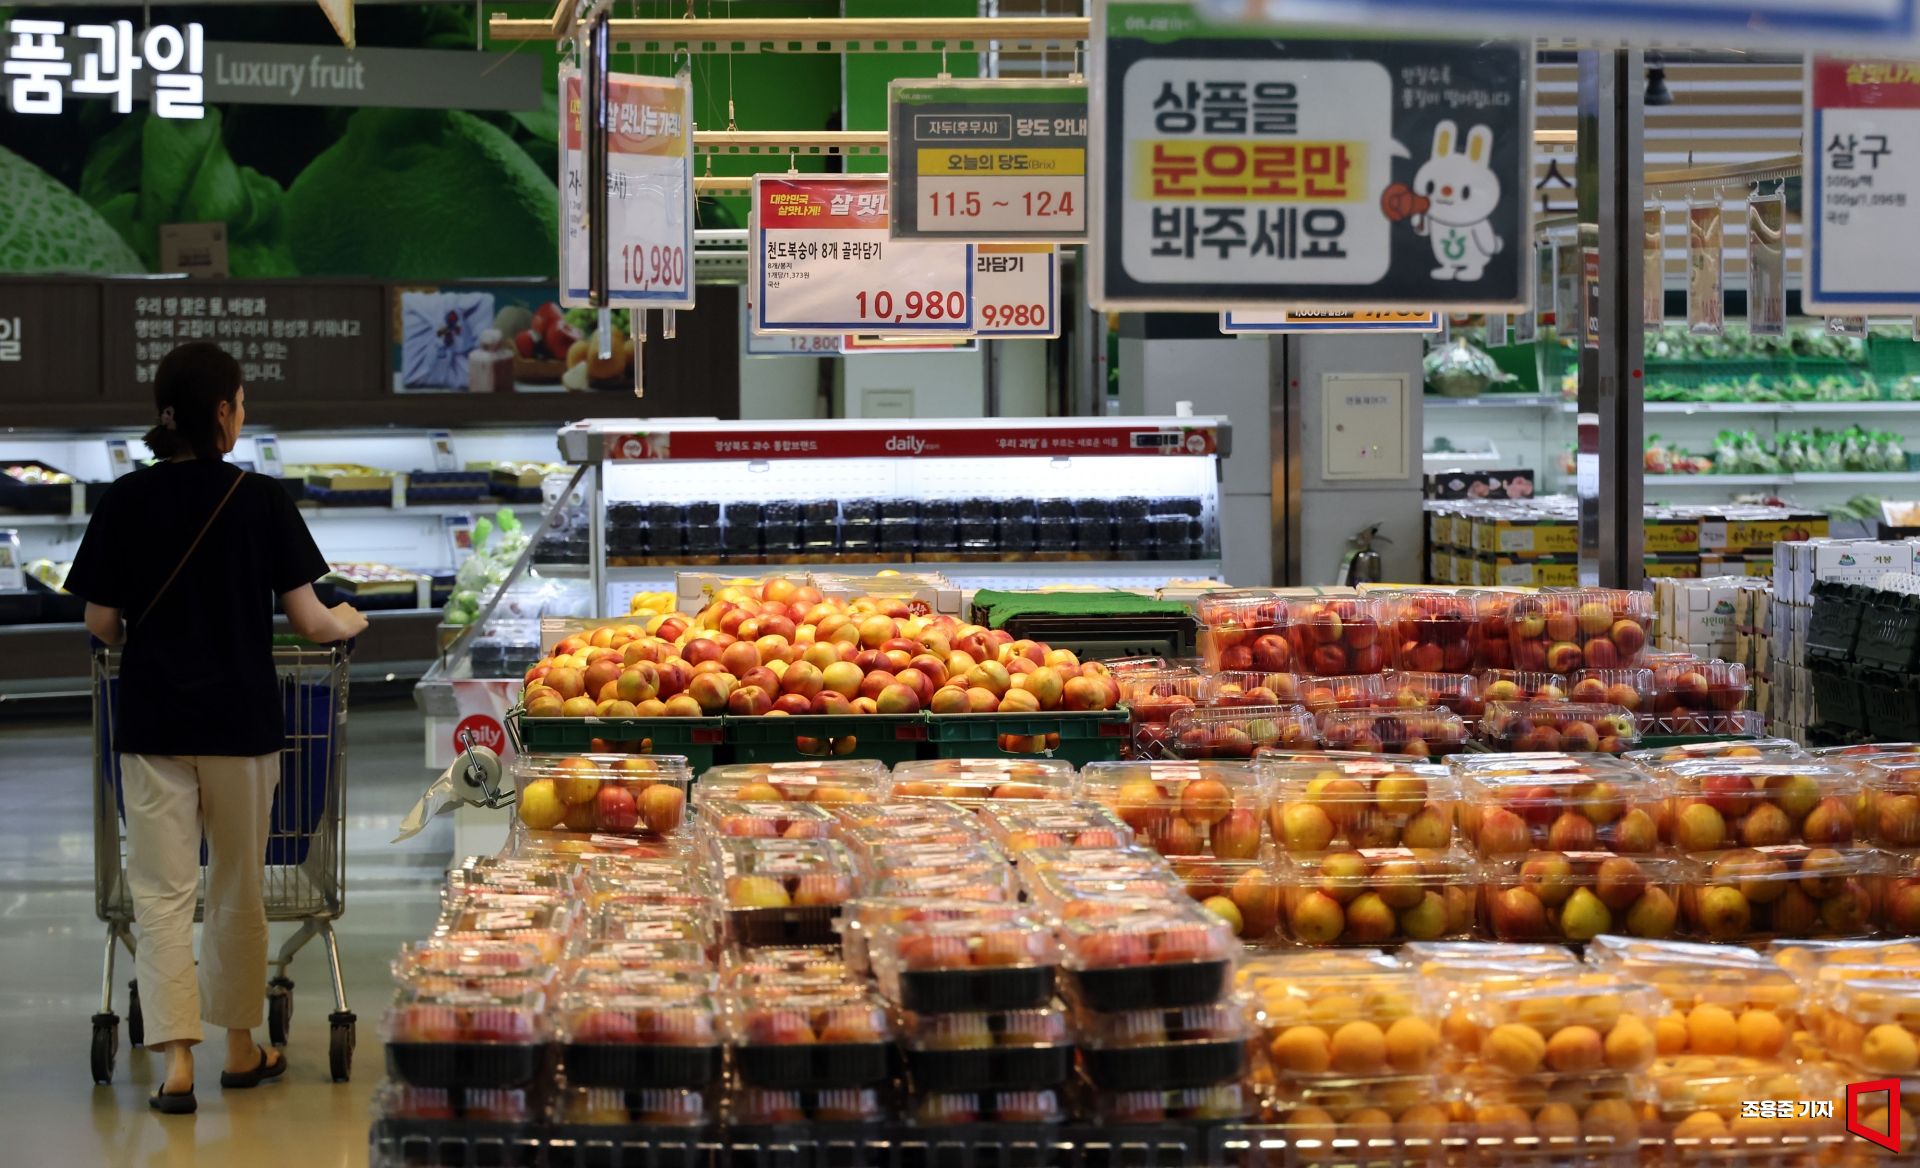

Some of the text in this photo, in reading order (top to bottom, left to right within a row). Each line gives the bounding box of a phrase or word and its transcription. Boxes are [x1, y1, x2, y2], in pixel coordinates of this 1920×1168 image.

[3, 18, 205, 120] 품과일
[215, 54, 366, 96] Luxury fruit
[1153, 81, 1298, 134] 상품을
[620, 103, 658, 136] 맛나는
[929, 118, 1087, 137] 자두(후무사) 당도 안내
[948, 154, 994, 170] 오늘의
[1826, 134, 1892, 170] 살구
[1152, 144, 1350, 197] 눈으로만
[770, 193, 809, 205] 대한민국
[831, 193, 853, 217] 살
[929, 191, 981, 217] 11.5
[1022, 191, 1075, 217] 12.4
[778, 205, 821, 217] 살맛나게!
[1151, 206, 1348, 260] 봐주세요
[768, 241, 882, 260] 천도복숭아 8개 골라담기
[622, 244, 684, 291] 10,980
[767, 262, 792, 270] 8개/봉지
[767, 271, 810, 280] 1개당/1,373원
[767, 281, 780, 289] 국산
[856, 290, 965, 324] 10,980
[981, 304, 1045, 327] 9,980
[791, 337, 839, 351] 12,800
[885, 435, 926, 454] daily
